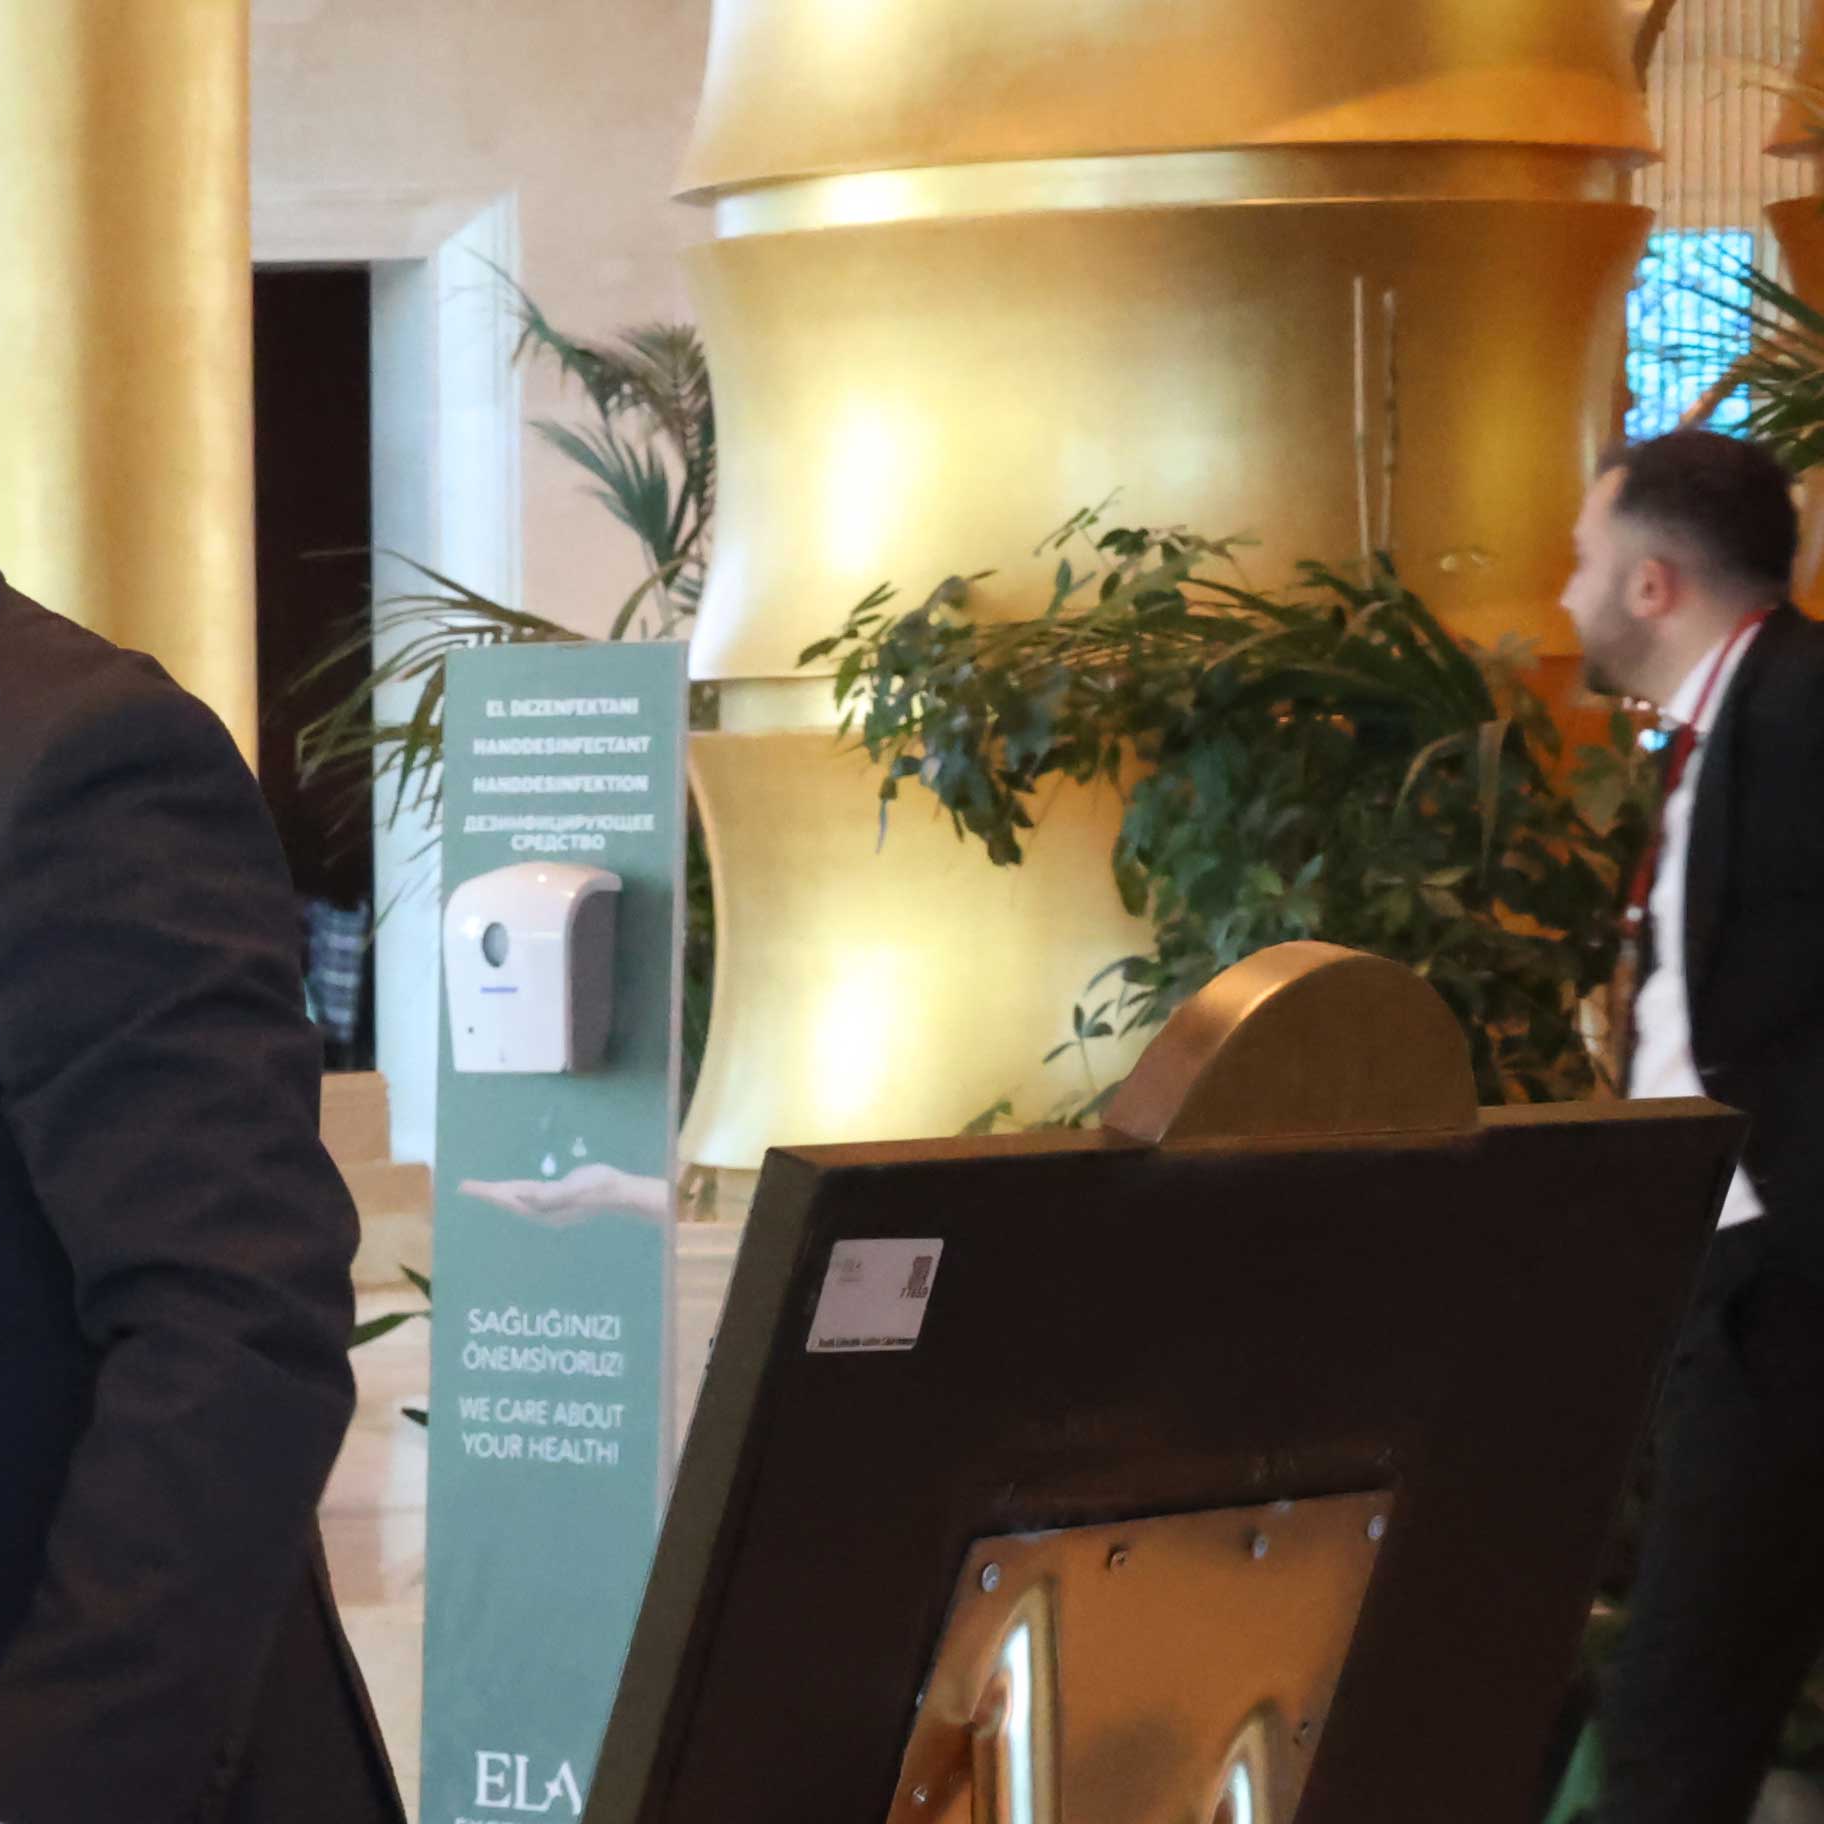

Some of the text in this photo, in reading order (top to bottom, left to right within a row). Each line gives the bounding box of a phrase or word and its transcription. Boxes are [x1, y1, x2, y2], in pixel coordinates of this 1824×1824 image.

[467, 1306, 621, 1341] SAĞLIĞINIZI
[458, 1396, 625, 1430] WE CARE ABOUT
[461, 1431, 619, 1465] YOUR HEALTH!
[475, 1750, 582, 1816] ELA
